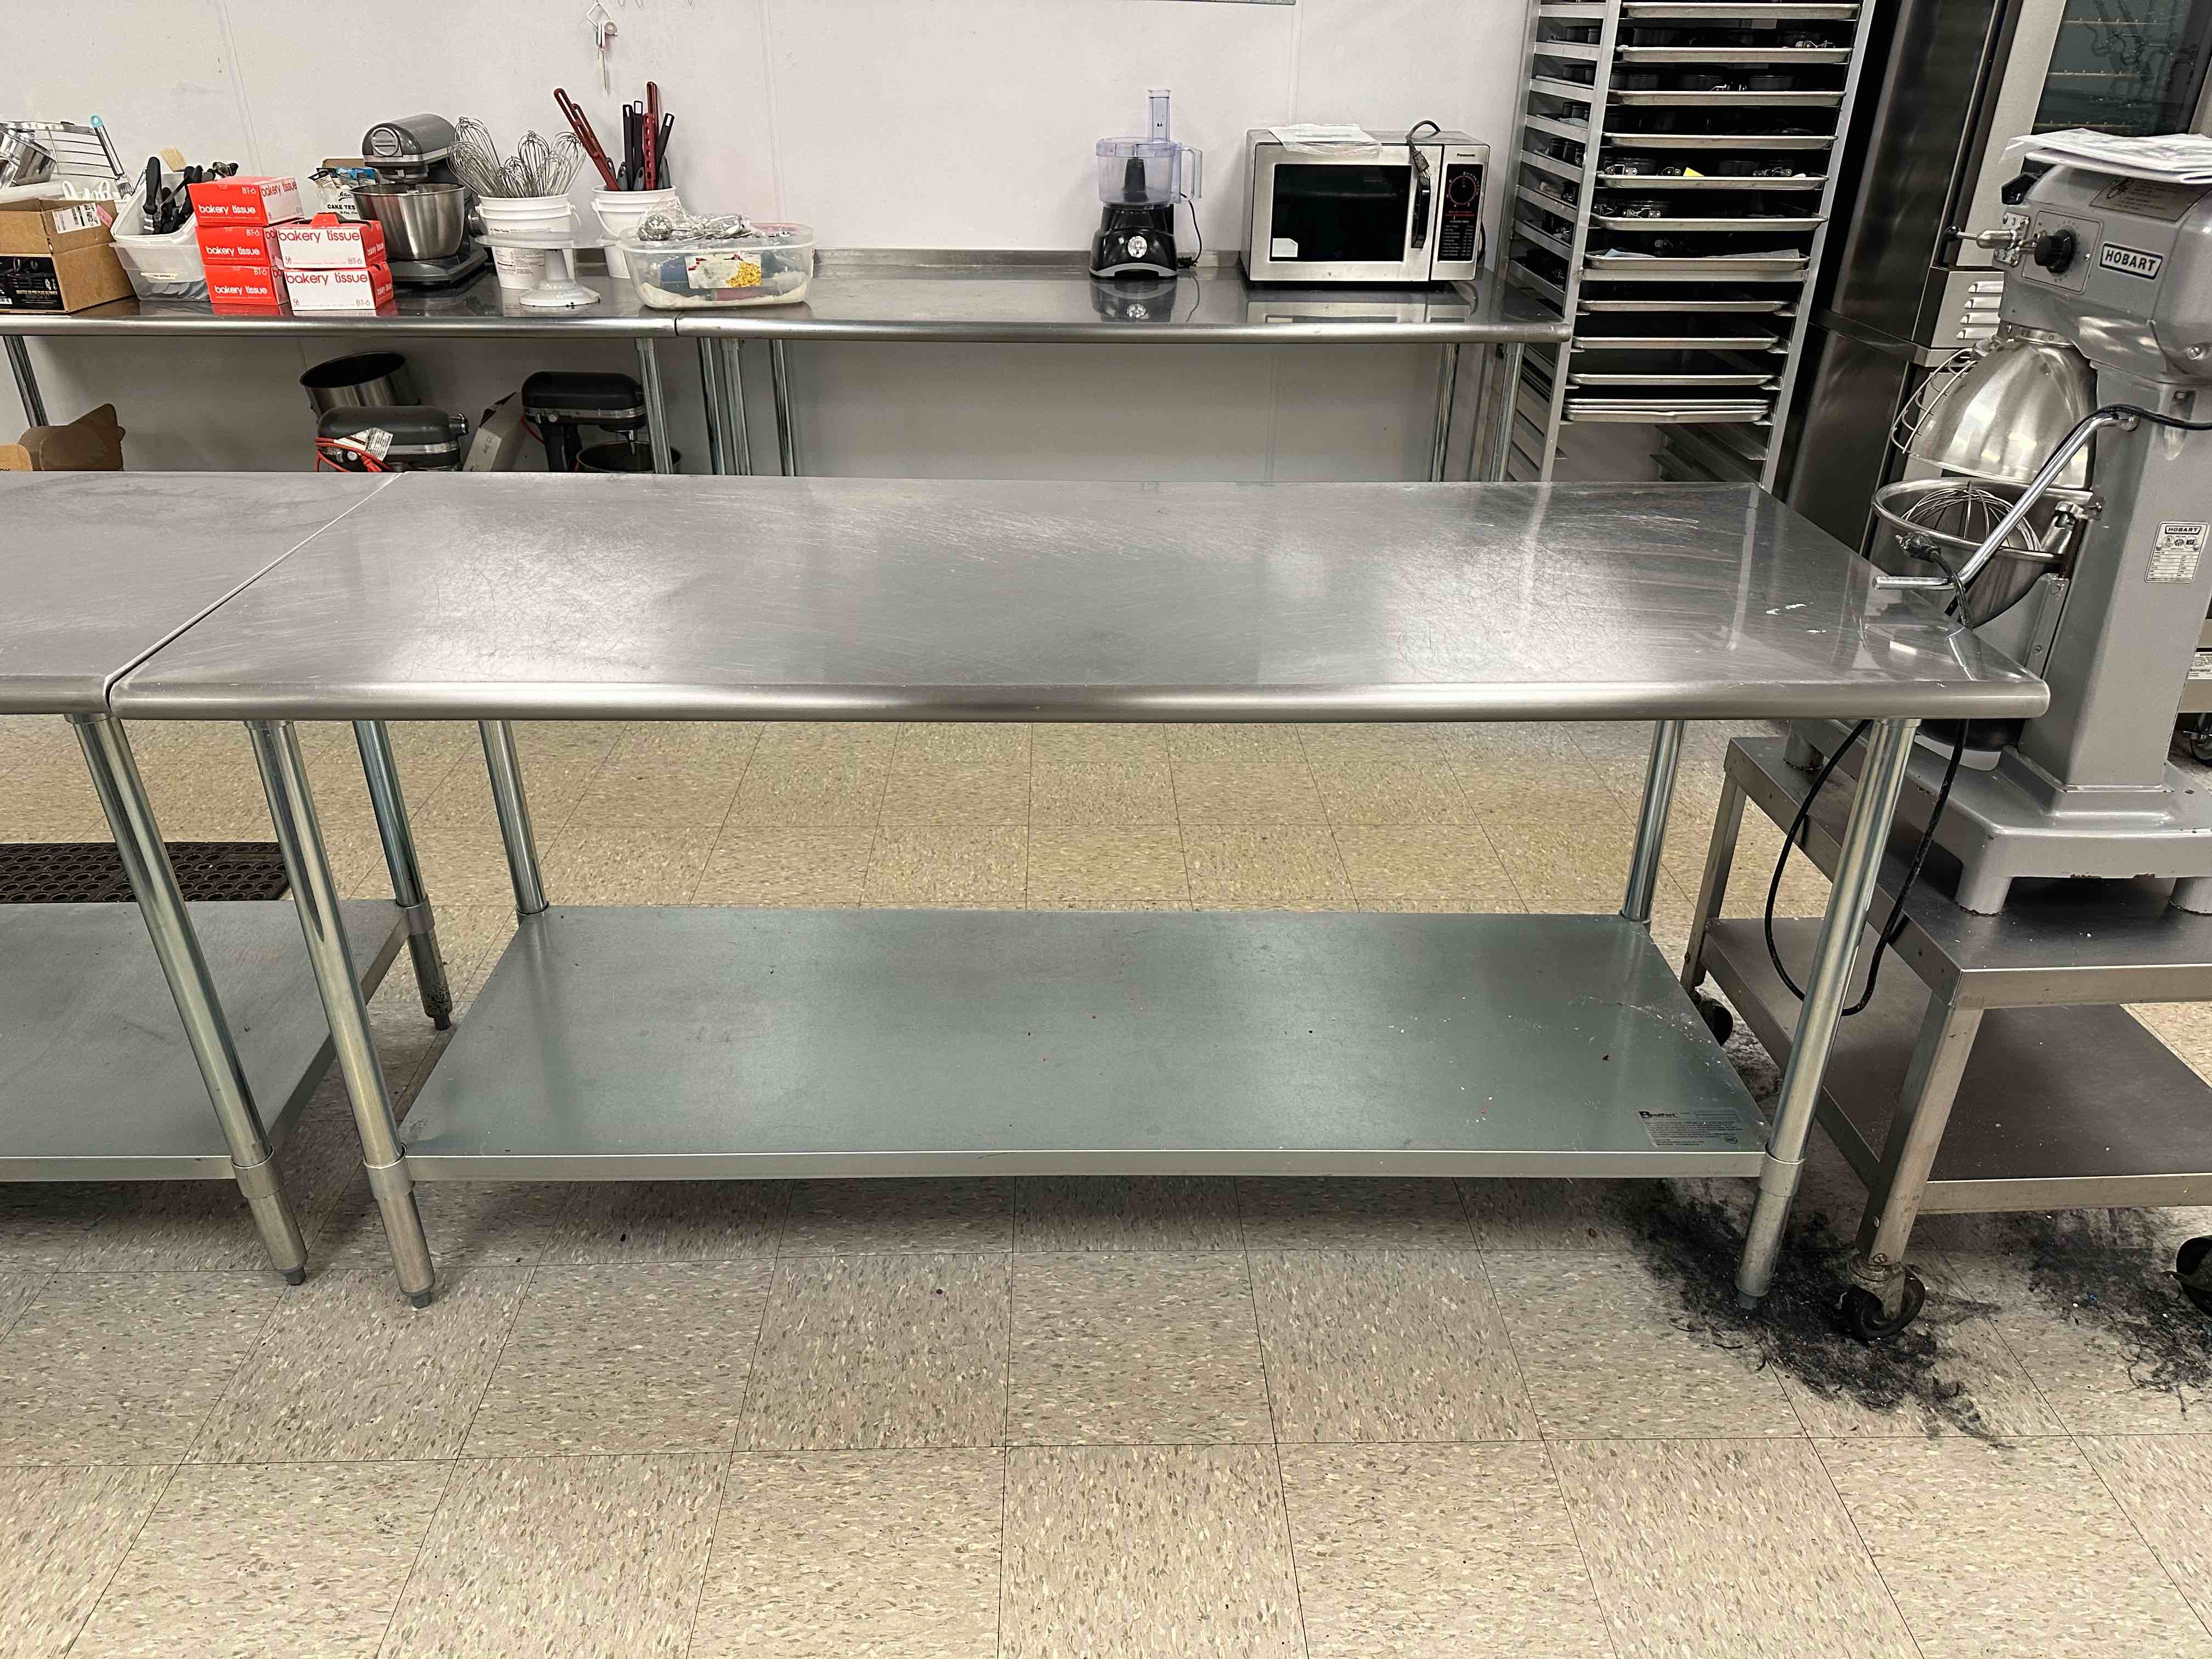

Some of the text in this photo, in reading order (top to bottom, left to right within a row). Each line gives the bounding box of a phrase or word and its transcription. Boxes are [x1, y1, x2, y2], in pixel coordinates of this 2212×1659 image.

[261, 180, 297, 197] bakery tissue
[198, 204, 256, 215] bakery tissue
[278, 230, 320, 243] bakery
[326, 230, 360, 241] tissue
[206, 246, 260, 256] bakery tissue
[2105, 250, 2157, 272] HOBART
[286, 273, 329, 285] bakery
[335, 272, 368, 283] tissue
[215, 285, 268, 295] bakery tissue
